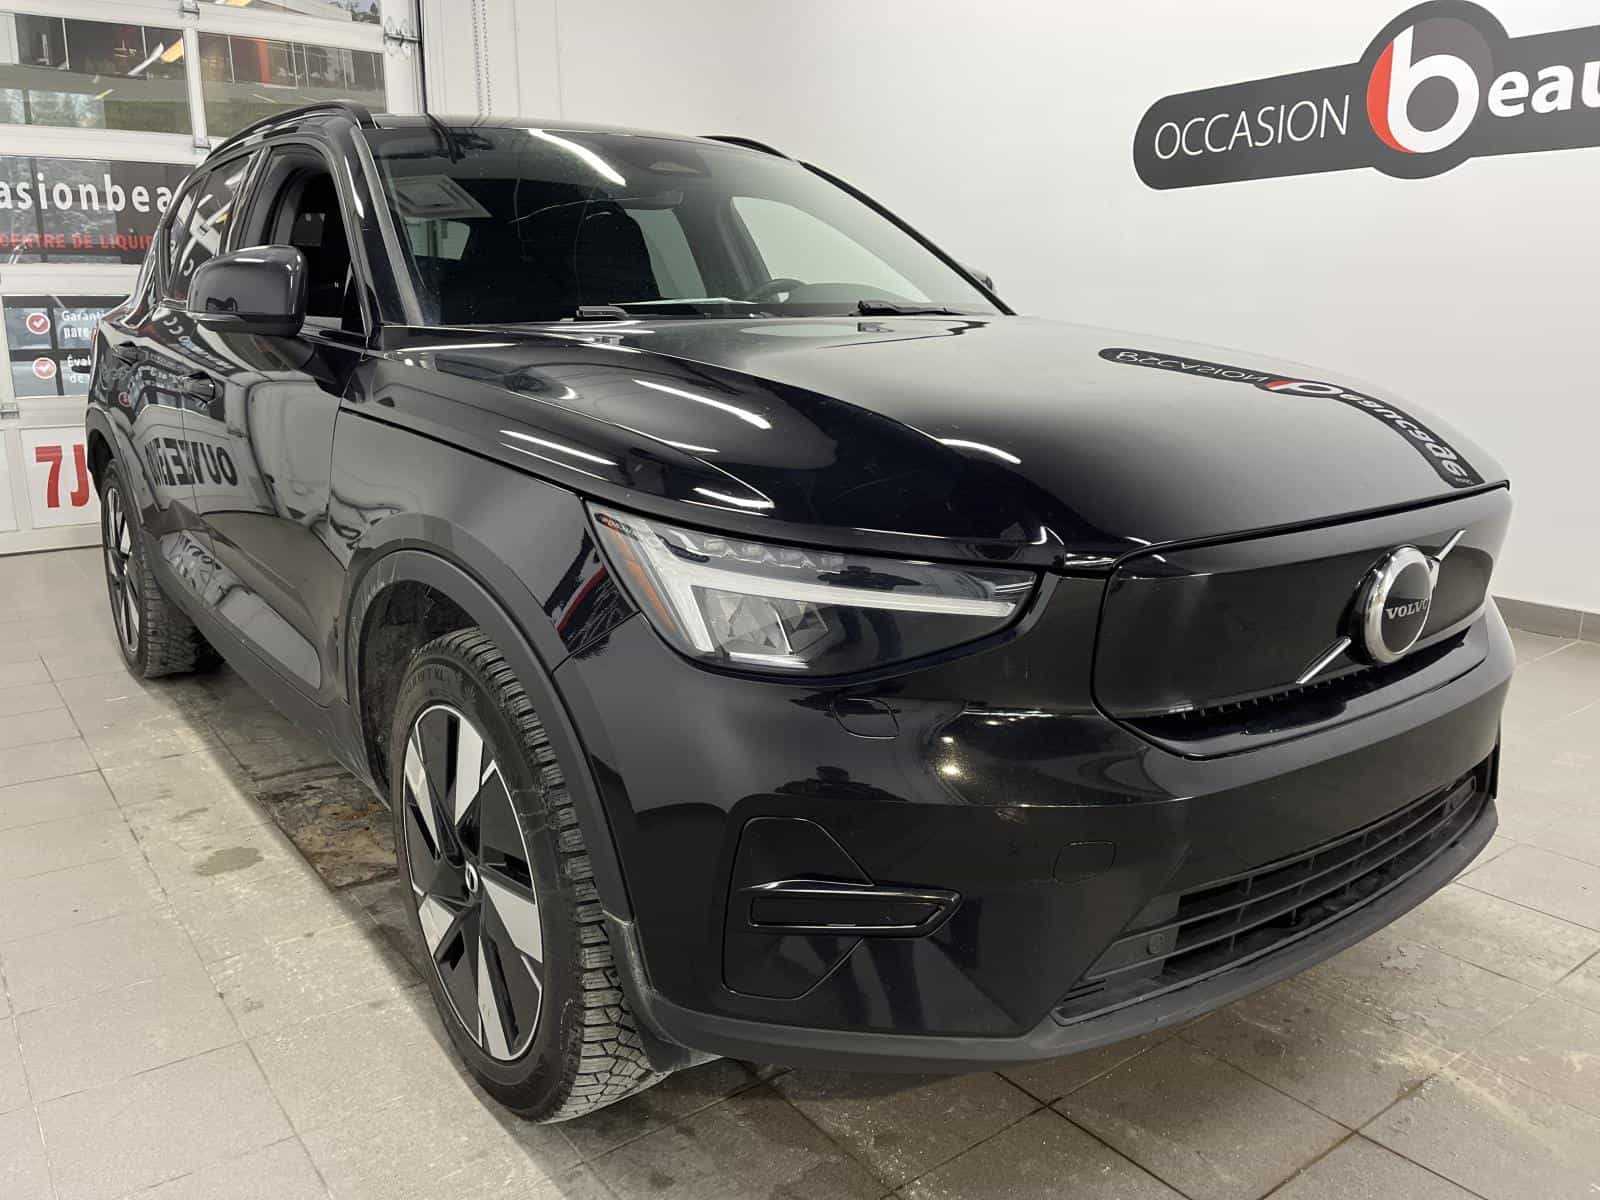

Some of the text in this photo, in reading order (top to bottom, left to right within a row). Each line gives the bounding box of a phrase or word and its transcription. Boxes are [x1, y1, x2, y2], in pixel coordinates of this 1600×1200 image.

[1154, 94, 1350, 160] OCCASION
[72, 232, 94, 249] DE
[1385, 598, 1428, 620] VOLVO
